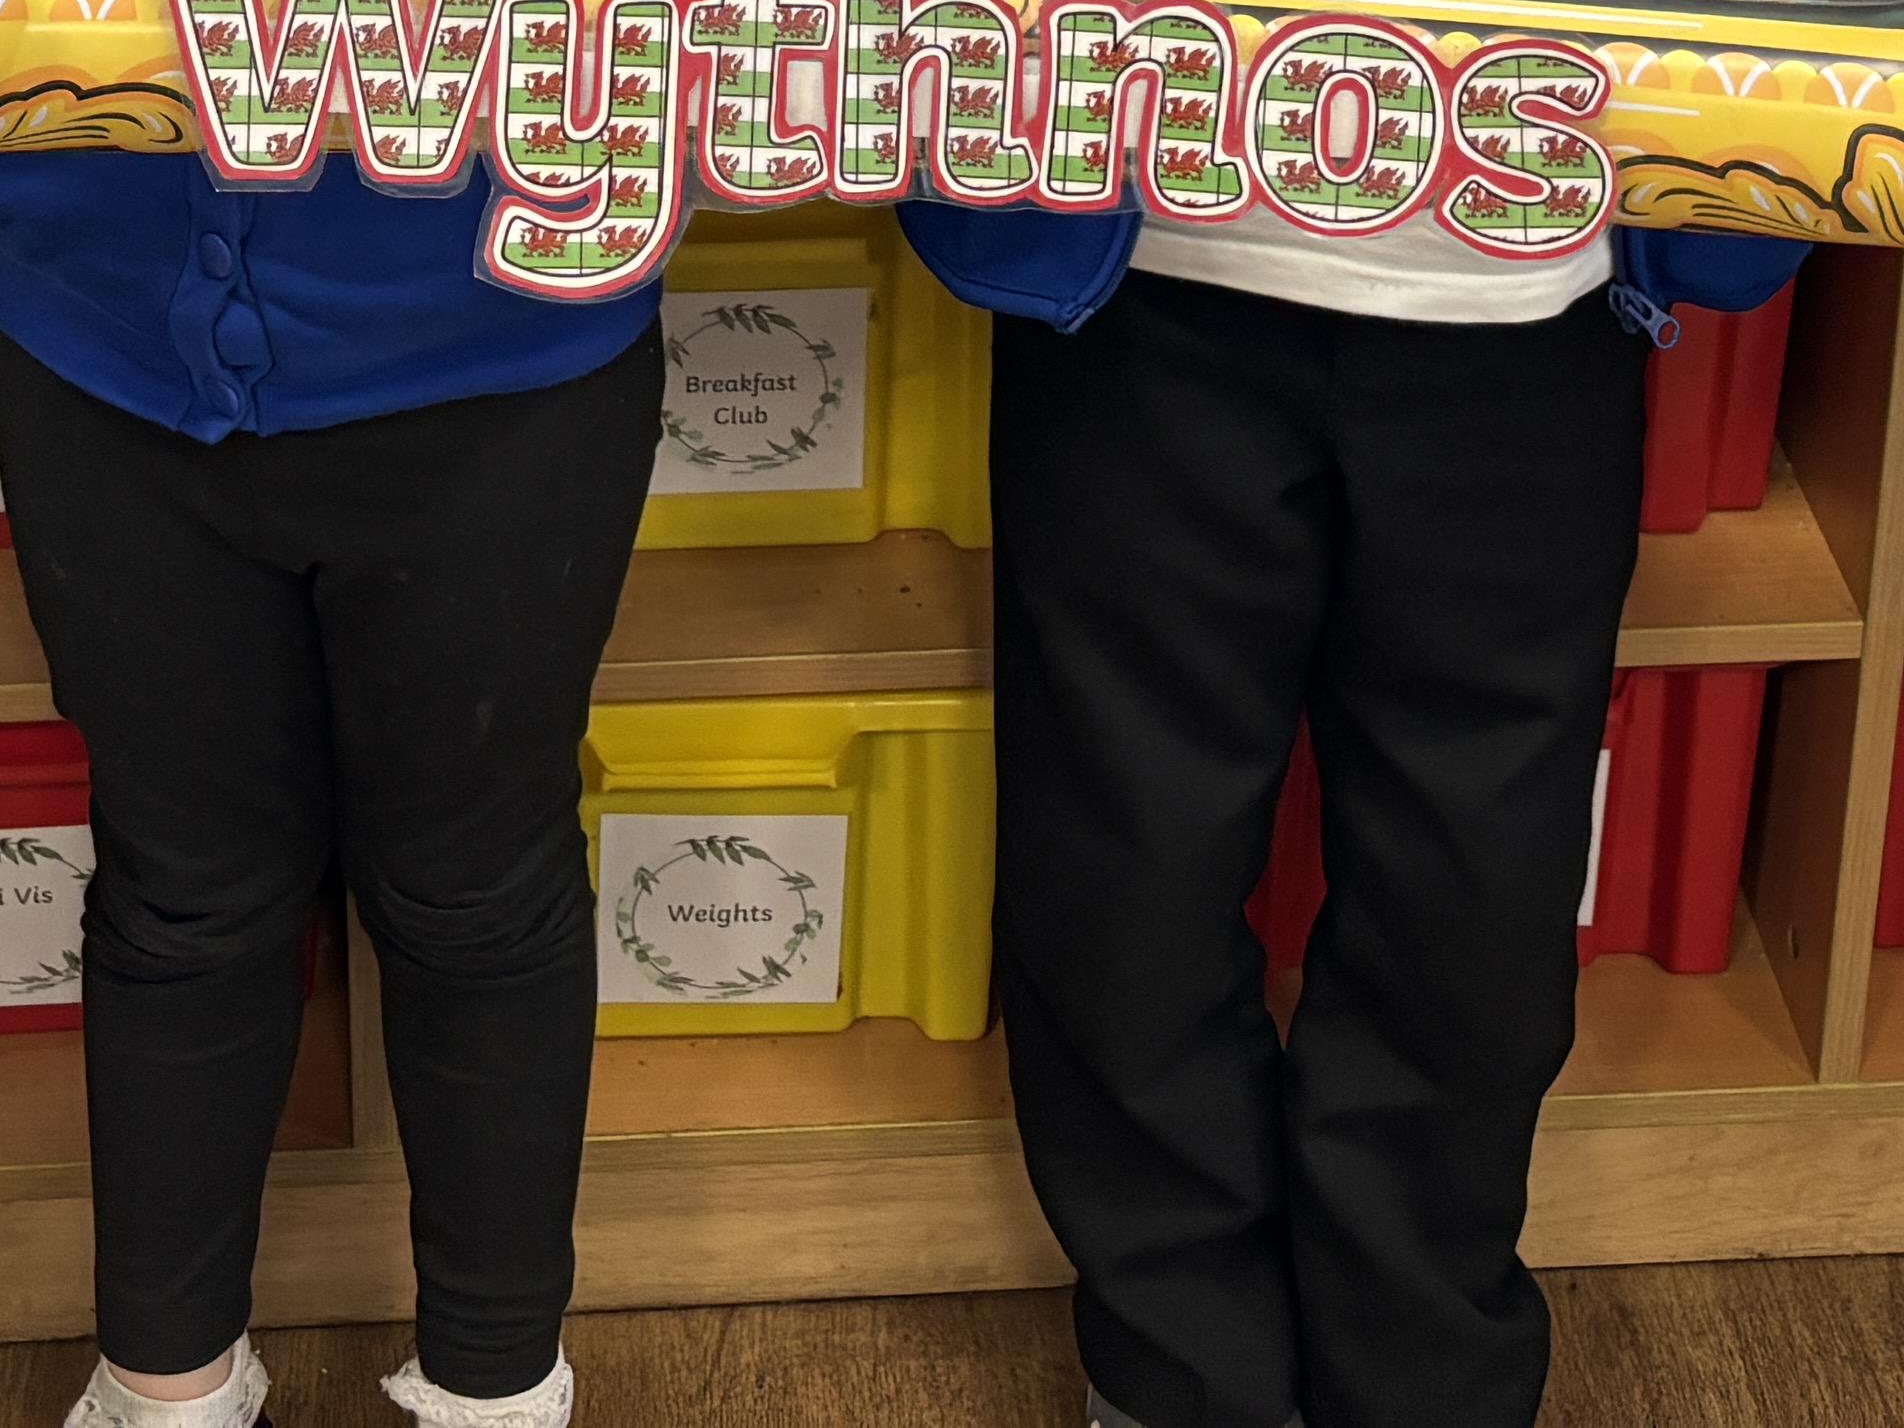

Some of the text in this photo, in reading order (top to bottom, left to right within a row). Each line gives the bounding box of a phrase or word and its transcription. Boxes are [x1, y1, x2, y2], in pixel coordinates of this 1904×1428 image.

[686, 372, 795, 397] Breakfast
[714, 407, 768, 425] Club
[14, 887, 53, 905] Vis
[667, 903, 772, 928] Weights
